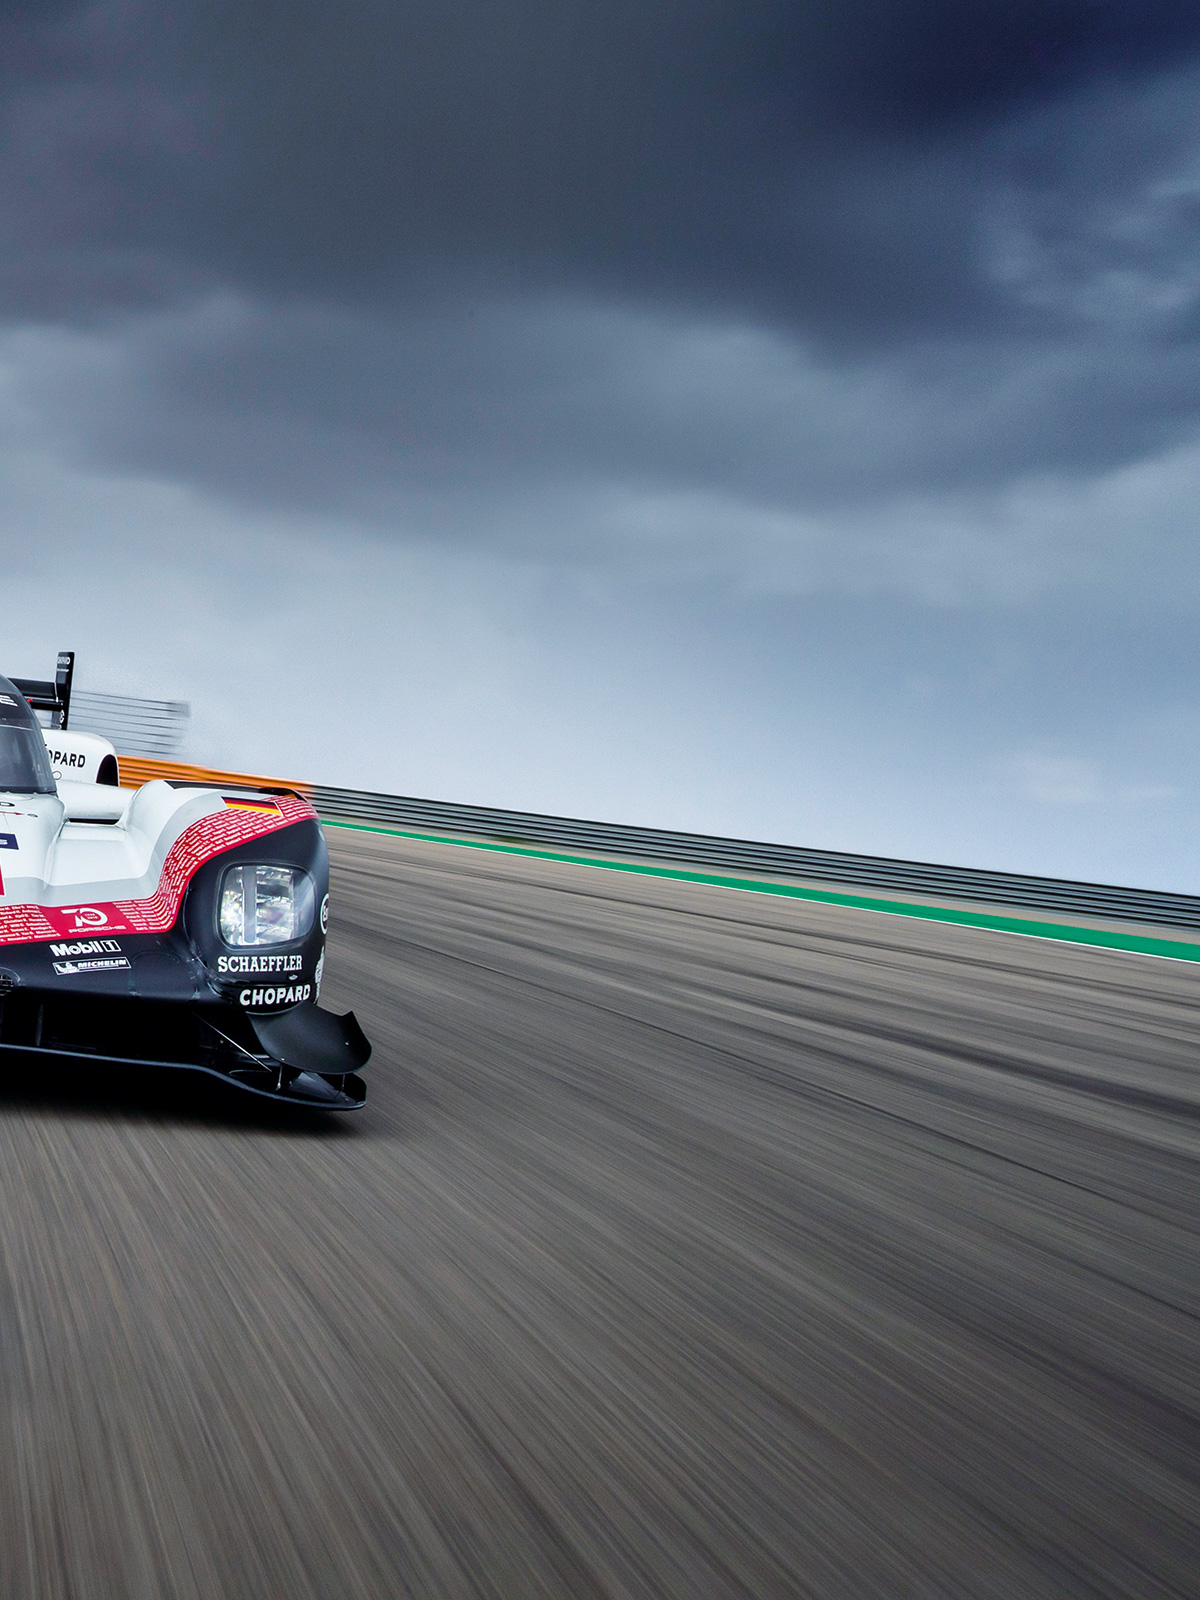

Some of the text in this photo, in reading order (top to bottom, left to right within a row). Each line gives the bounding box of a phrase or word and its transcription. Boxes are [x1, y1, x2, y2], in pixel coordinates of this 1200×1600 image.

[47, 748, 86, 768] PARD
[68, 925, 127, 933] PORSCHE
[49, 941, 104, 957] Mobil
[77, 959, 127, 969] MICHELIN
[217, 955, 303, 973] SCHAEFFLER
[240, 984, 311, 1006] CHOPARD
